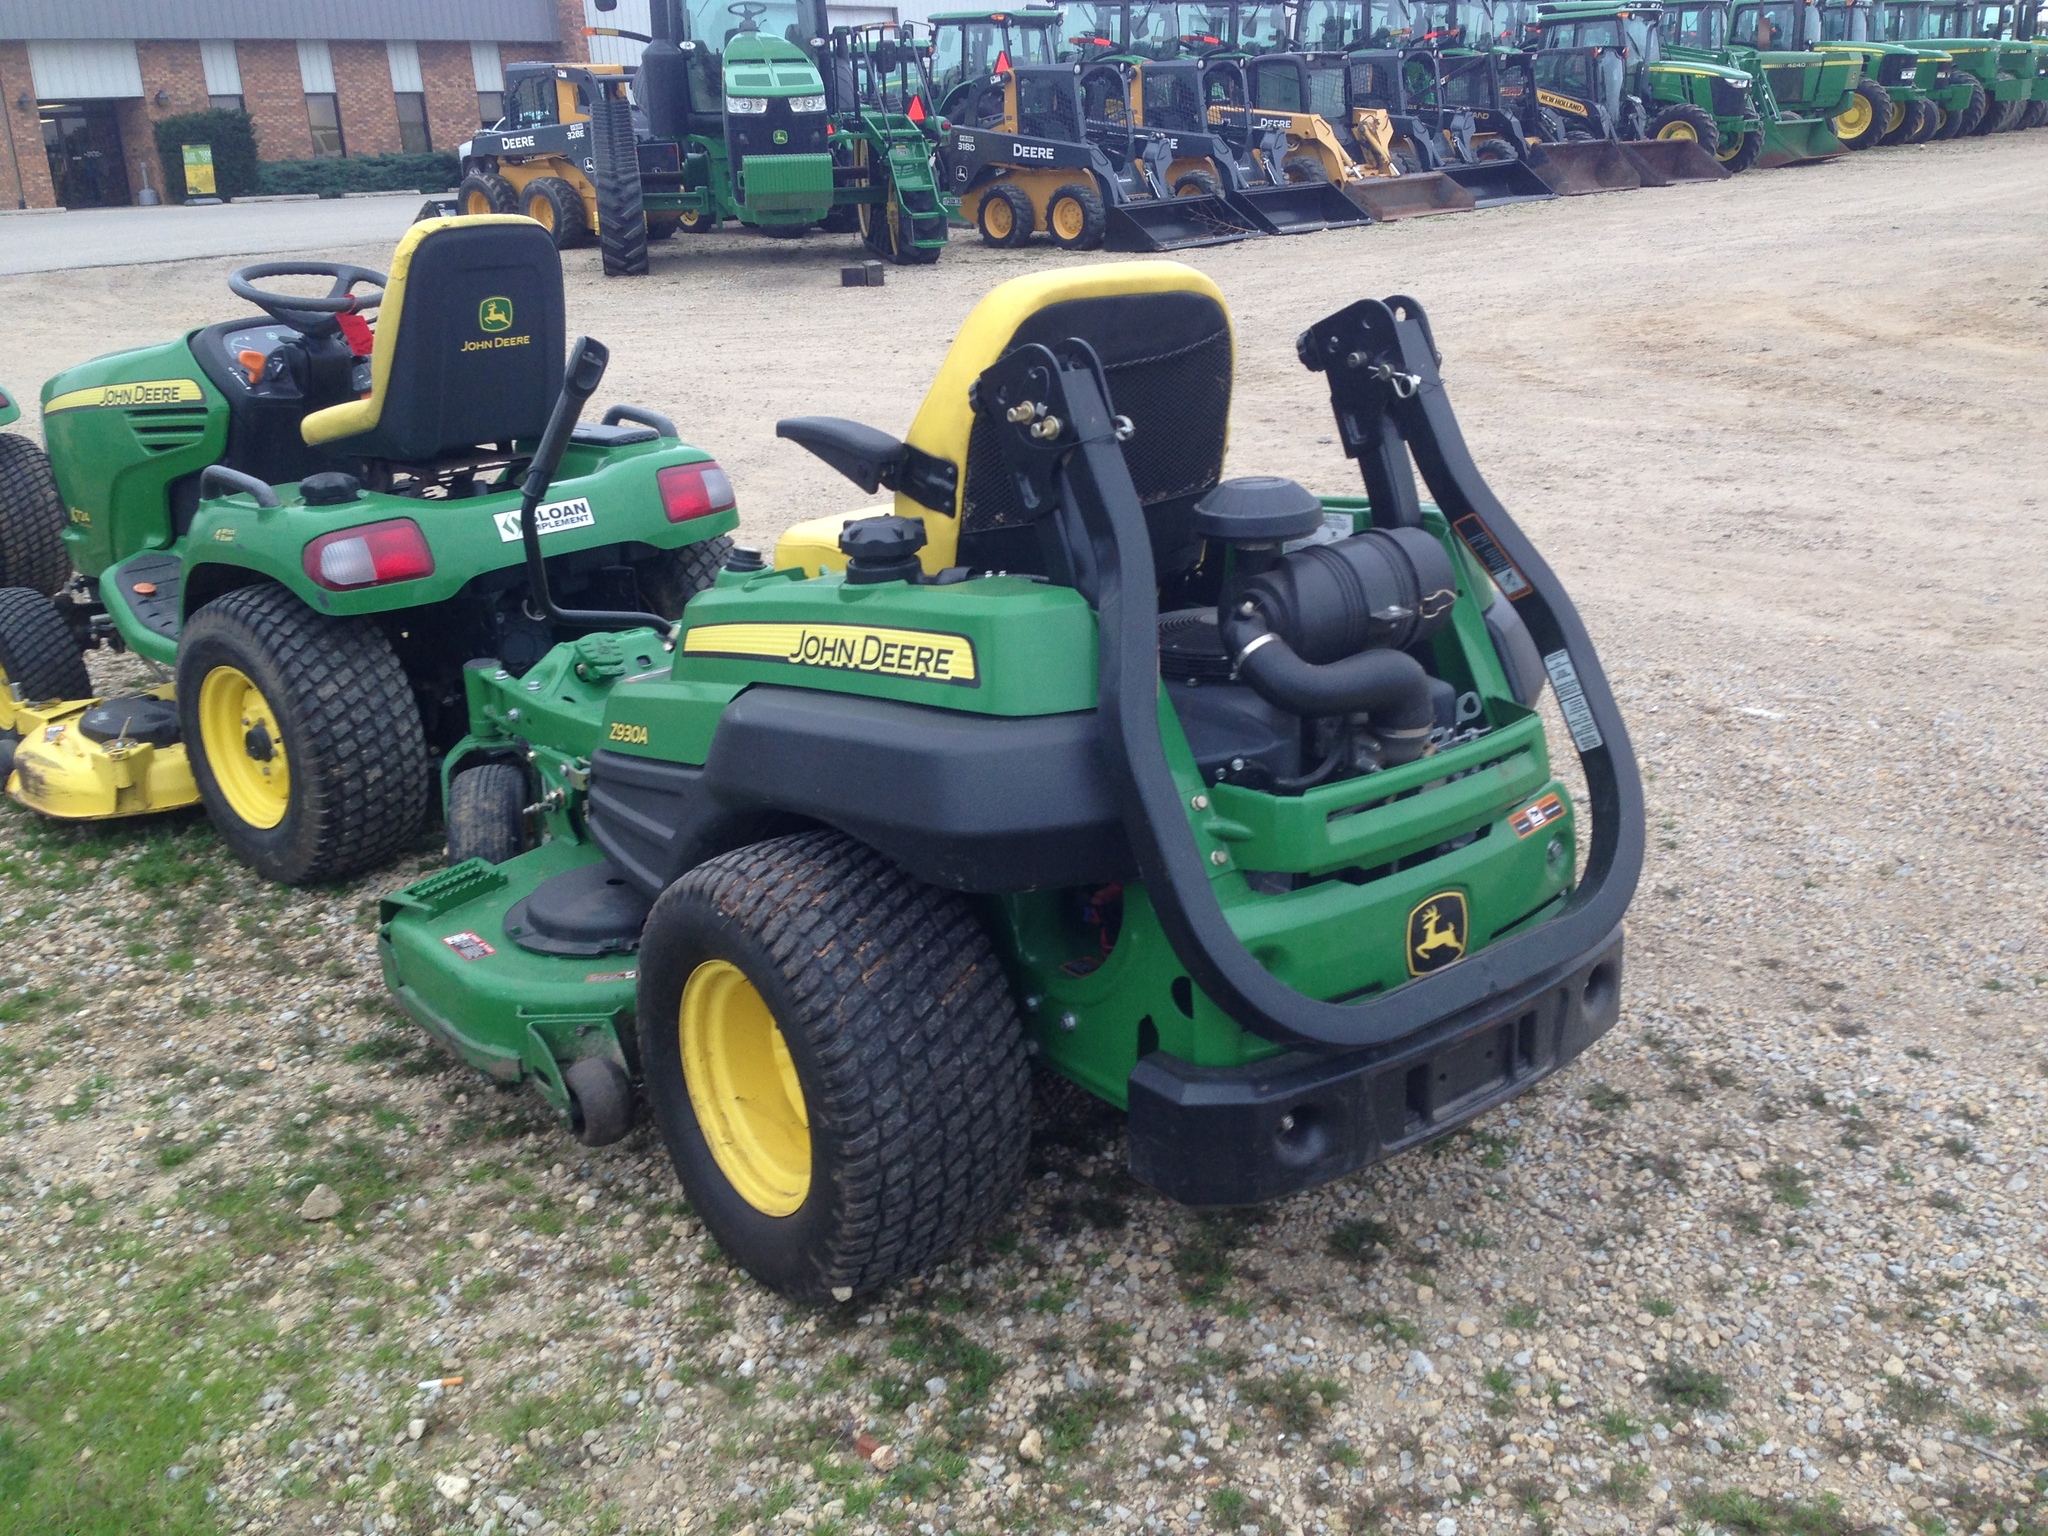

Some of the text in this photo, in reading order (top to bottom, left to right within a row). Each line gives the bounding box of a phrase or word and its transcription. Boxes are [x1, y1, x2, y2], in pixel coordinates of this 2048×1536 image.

[1541, 94, 1582, 112] NEW HOLLAND
[501, 135, 535, 150] DEERE
[957, 142, 976, 151] 318D
[1013, 143, 1054, 159] DEERE
[460, 335, 530, 352] JOHN DEERE
[100, 385, 180, 405] JOHN DEERE
[535, 502, 588, 522] LOAN
[536, 514, 590, 531] PLEMENT
[791, 629, 954, 675] JOHN DEERE
[608, 722, 649, 745] Z930A
